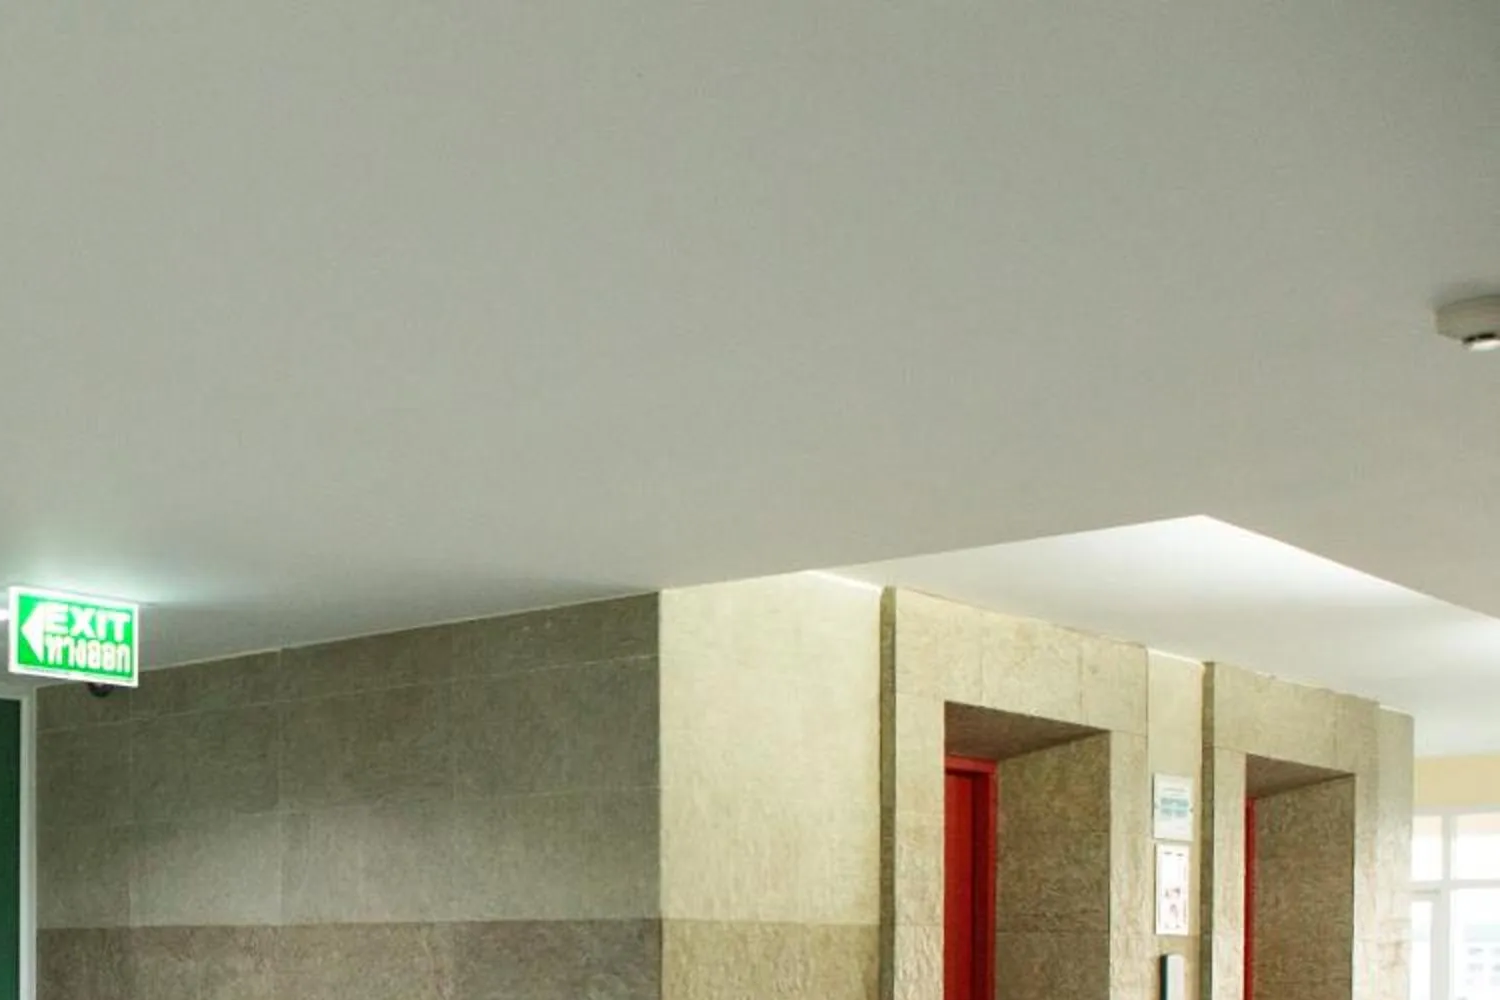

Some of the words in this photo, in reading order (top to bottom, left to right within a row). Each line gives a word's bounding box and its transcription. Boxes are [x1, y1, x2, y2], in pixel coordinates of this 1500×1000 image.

[44, 602, 132, 642] EXIT
[45, 634, 131, 673] ทางออก
